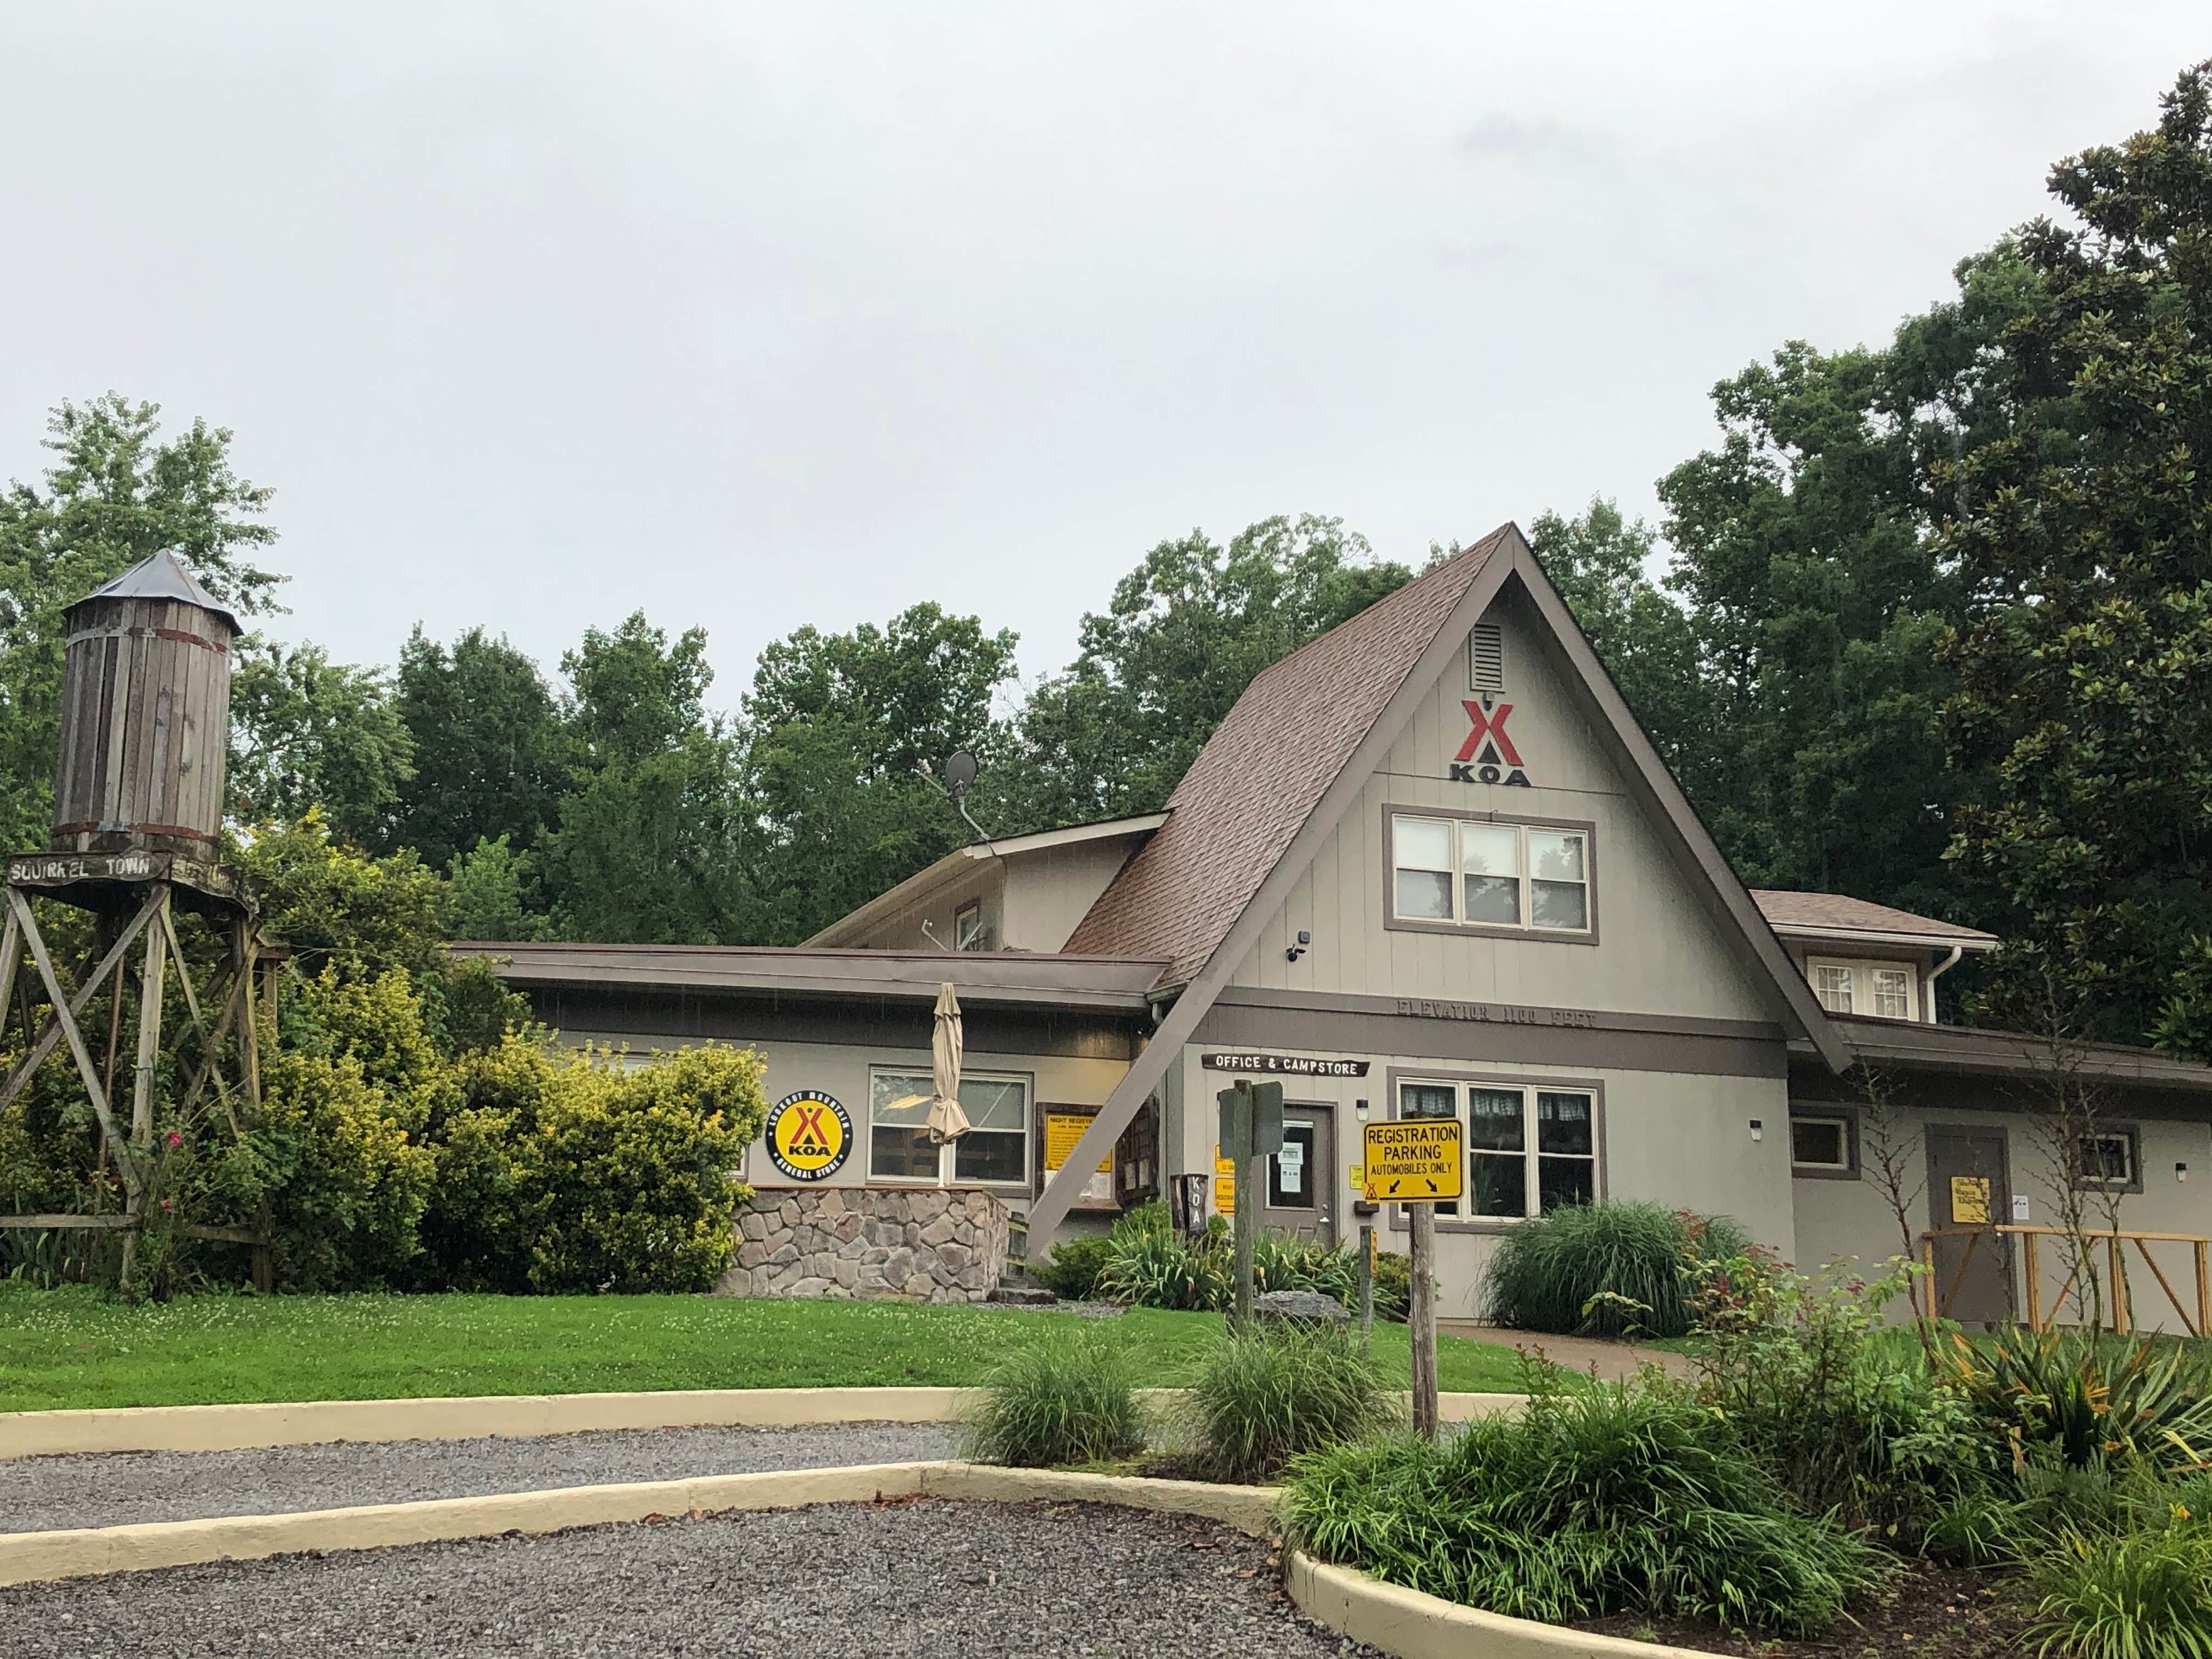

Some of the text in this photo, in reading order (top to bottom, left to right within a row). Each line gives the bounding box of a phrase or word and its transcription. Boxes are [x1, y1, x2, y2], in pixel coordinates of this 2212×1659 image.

[1449, 764, 1532, 787] KOA
[106, 857, 151, 875] TOWN
[1397, 1000, 1596, 1028] ELEVATION 1100 FEET
[1216, 1055, 1358, 1075] OFFICE & CAMPSTORE
[769, 1092, 850, 1128] LOOKOUT MOUNTAIN
[1368, 1126, 1458, 1144] REGISTRATION
[788, 1145, 832, 1156] KOA
[1384, 1144, 1442, 1161] PARKING
[776, 1158, 840, 1179] GENERAL STORE
[1371, 1163, 1427, 1176] AUTOMOBILES
[1430, 1162, 1453, 1174] ONLY
[1192, 1176, 1200, 1223] KOA
